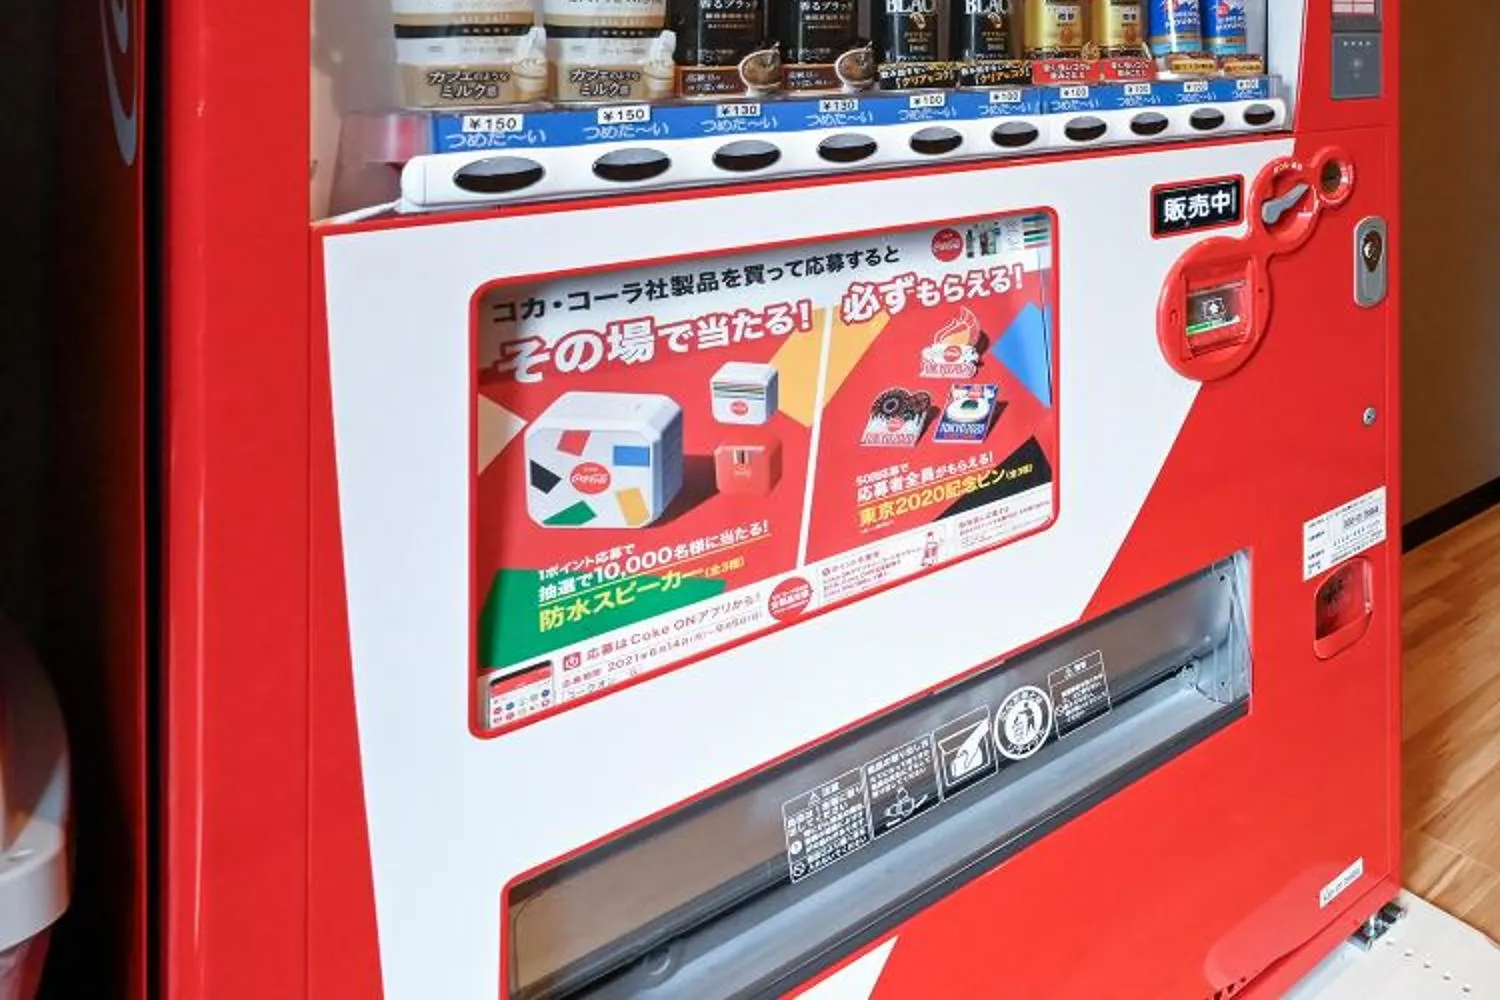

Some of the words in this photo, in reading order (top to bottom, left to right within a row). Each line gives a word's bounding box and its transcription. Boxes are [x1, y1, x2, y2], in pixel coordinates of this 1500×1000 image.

[469, 116, 517, 131] ¥150
[602, 109, 645, 121] ¥150
[721, 105, 757, 116] ¥130
[1163, 190, 1231, 223] 販売中
[493, 244, 900, 325] コカ・コーラ社製品を買って応募すると
[501, 298, 812, 385] その場で当たる!
[843, 265, 1025, 326] 必ずもらえる!
[859, 469, 1005, 526] 東京2020記念ピン
[539, 519, 769, 603] 抽選で10,000名様に当たる!
[540, 567, 704, 632] 防水スピーカー
